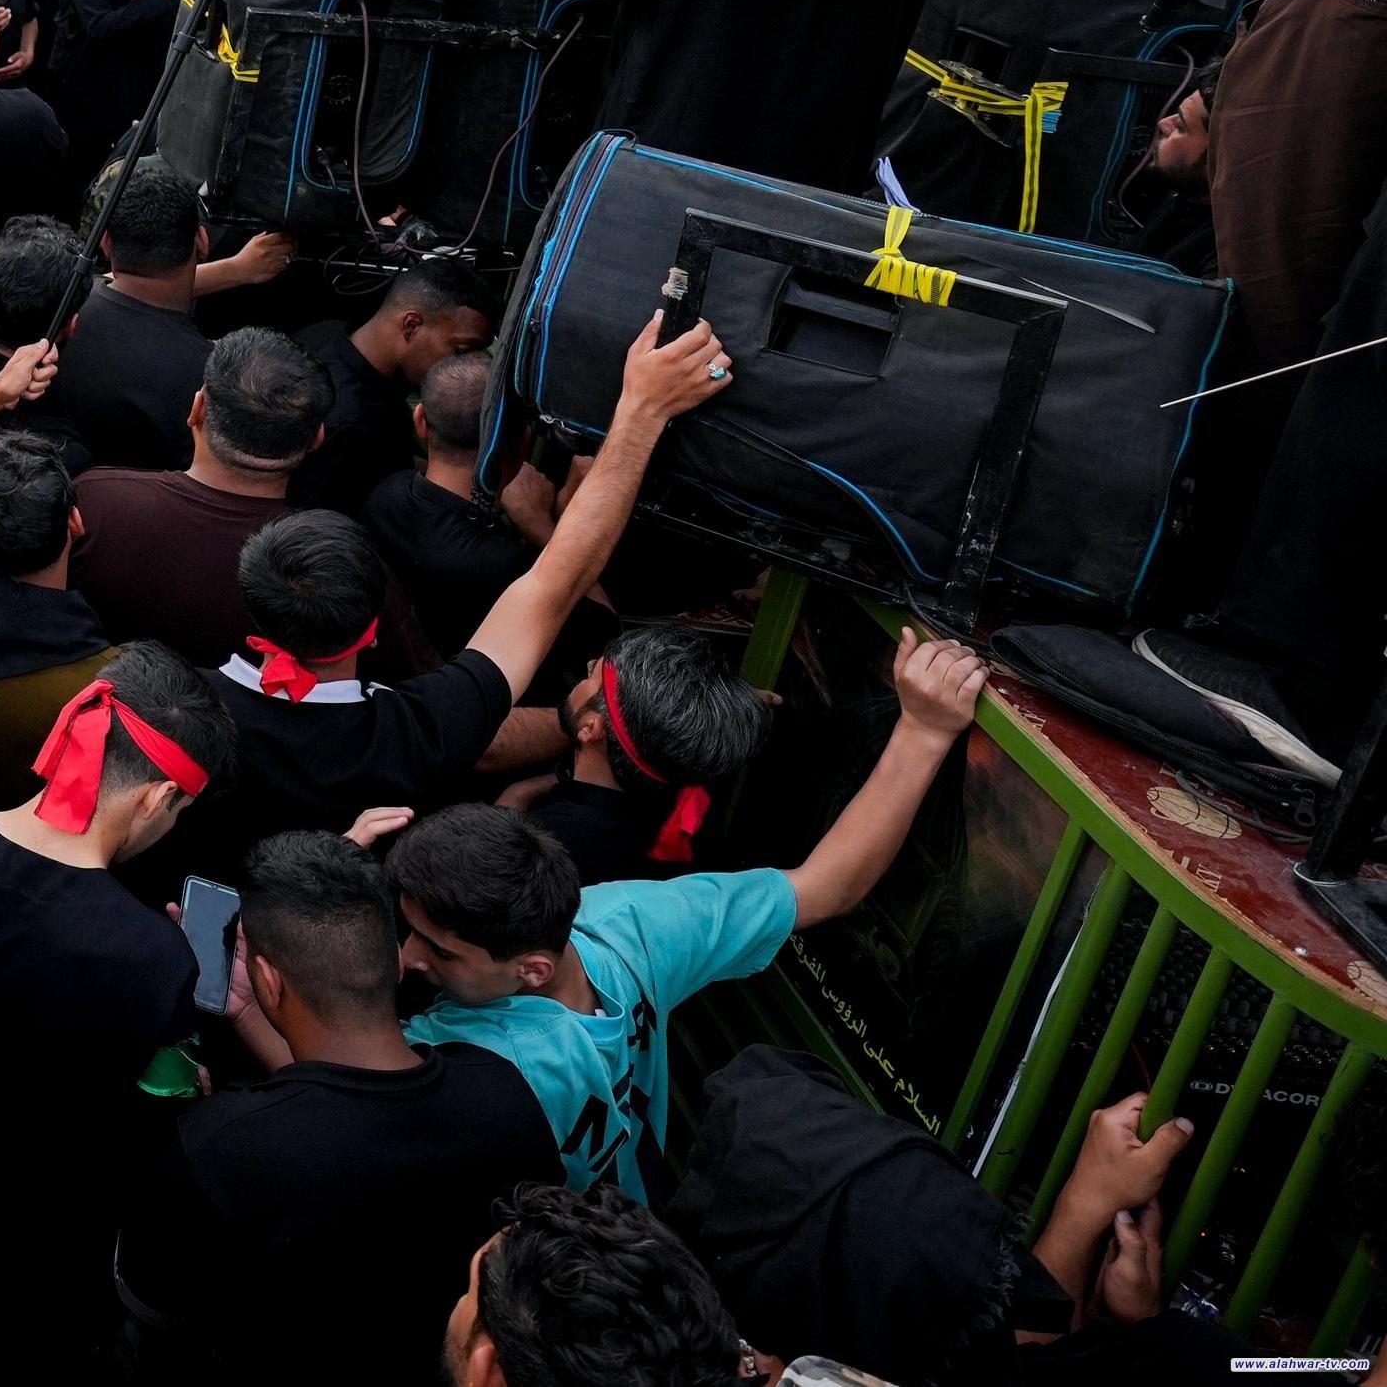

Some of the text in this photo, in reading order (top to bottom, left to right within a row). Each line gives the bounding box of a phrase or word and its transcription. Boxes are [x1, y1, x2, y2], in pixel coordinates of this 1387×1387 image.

[821, 984, 868, 1039] الرؤوس
[862, 1040, 896, 1079] على
[894, 1077, 942, 1136] السلام
[1215, 1082, 1323, 1107] DACOR
